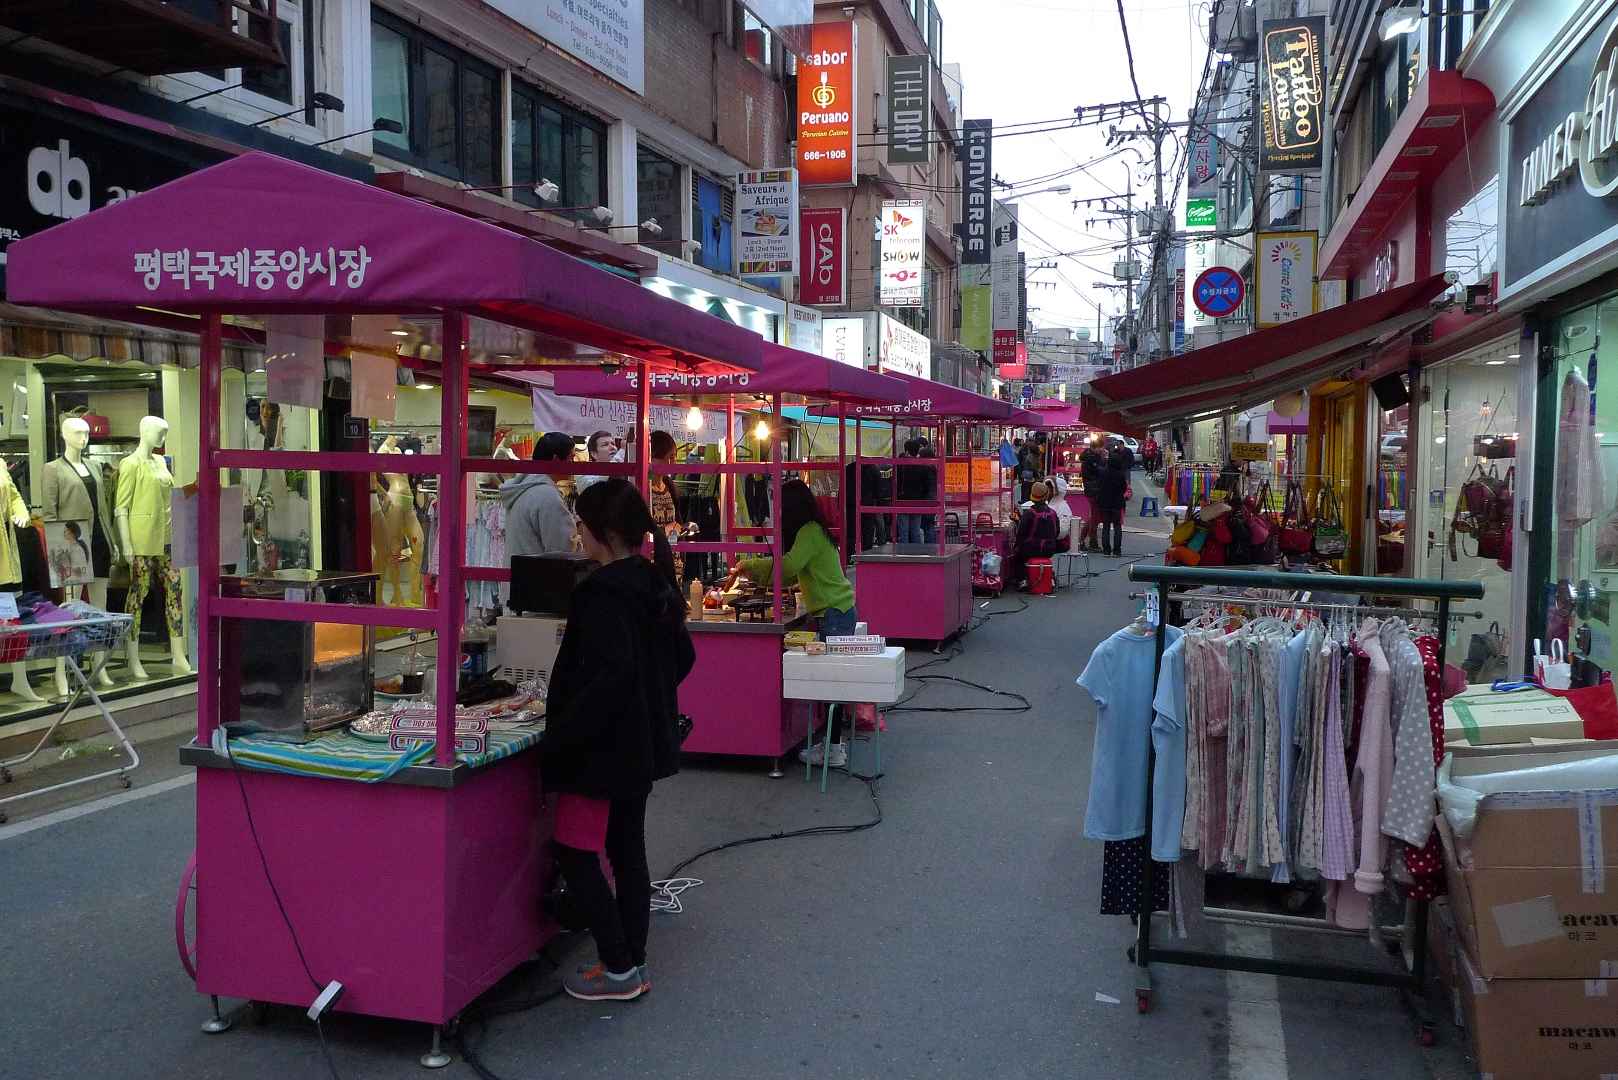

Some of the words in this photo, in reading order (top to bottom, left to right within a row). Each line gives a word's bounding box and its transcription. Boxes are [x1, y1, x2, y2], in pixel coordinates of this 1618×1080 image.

[1286, 33, 1322, 137] Tattoo
[801, 112, 849, 125] Peruano
[884, 225, 898, 235] SK
[134, 245, 371, 290] 평택국제중앙시장
[1538, 1027, 1617, 1037] macaw
